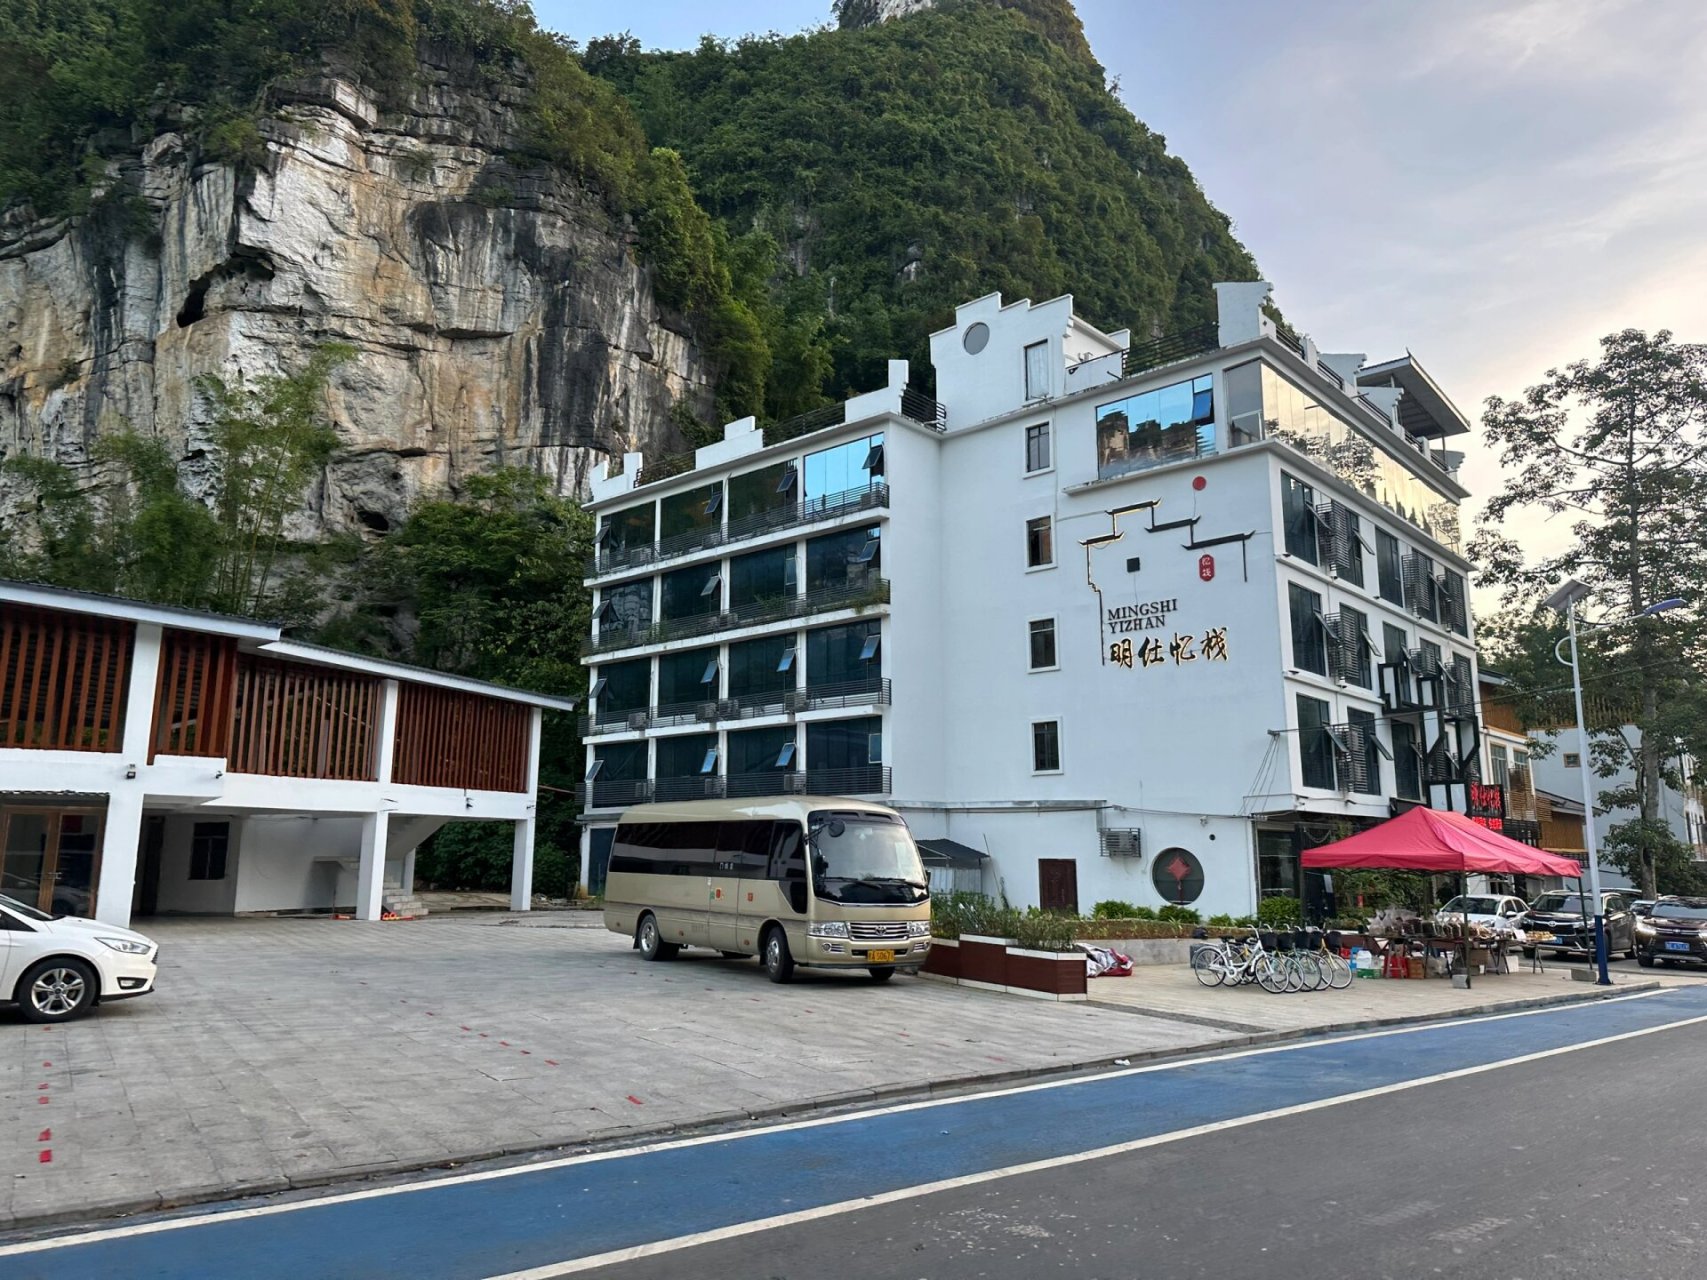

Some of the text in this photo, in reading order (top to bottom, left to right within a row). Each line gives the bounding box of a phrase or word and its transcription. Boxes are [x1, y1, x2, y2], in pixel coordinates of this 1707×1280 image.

[1107, 598, 1178, 621] MINGSHI
[1107, 614, 1166, 634] YIZHAN
[1109, 627, 1229, 669] 明仕忆栈
